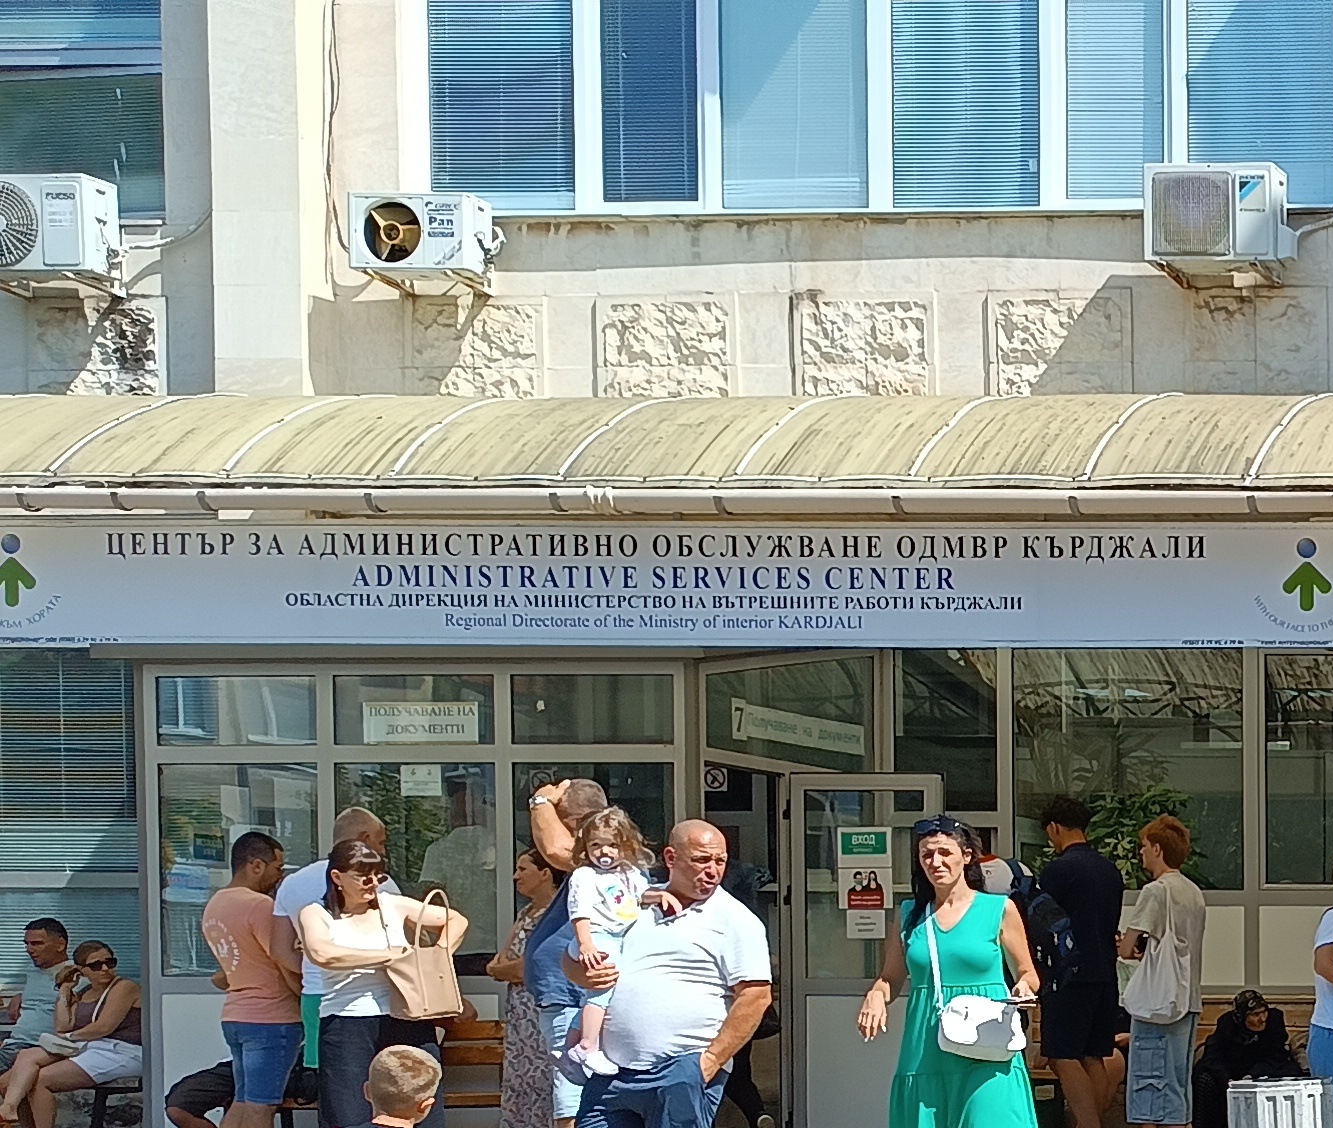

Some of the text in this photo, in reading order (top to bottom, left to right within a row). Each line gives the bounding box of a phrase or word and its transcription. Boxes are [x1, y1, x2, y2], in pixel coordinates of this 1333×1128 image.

[106, 532, 1206, 563] ЦЕНТЪР ЗА АДМИНИСТРАТИВНО ОБСЛУЖВАНЕ ОДМВР КЪРДЖАЛИ
[352, 565, 955, 590] ADMINISTRATIVE SERVICES CENTER
[285, 593, 1023, 612] ОБЛАСТНА ДИРЕКЦИЯ НА МИНИСТЕРСТВО НА ВЪТРЕШНИТЕ РАБОТИ КЪРДЖАЛИ
[444, 613, 863, 632] Regional Directorate of the Ministry of interior KARDJALI
[369, 706, 476, 717] ПОЛУЧАВАНЕ НА
[733, 706, 744, 733] 7
[386, 723, 465, 736] ДОКУМЕНТИ
[851, 834, 876, 846] ВХОД
